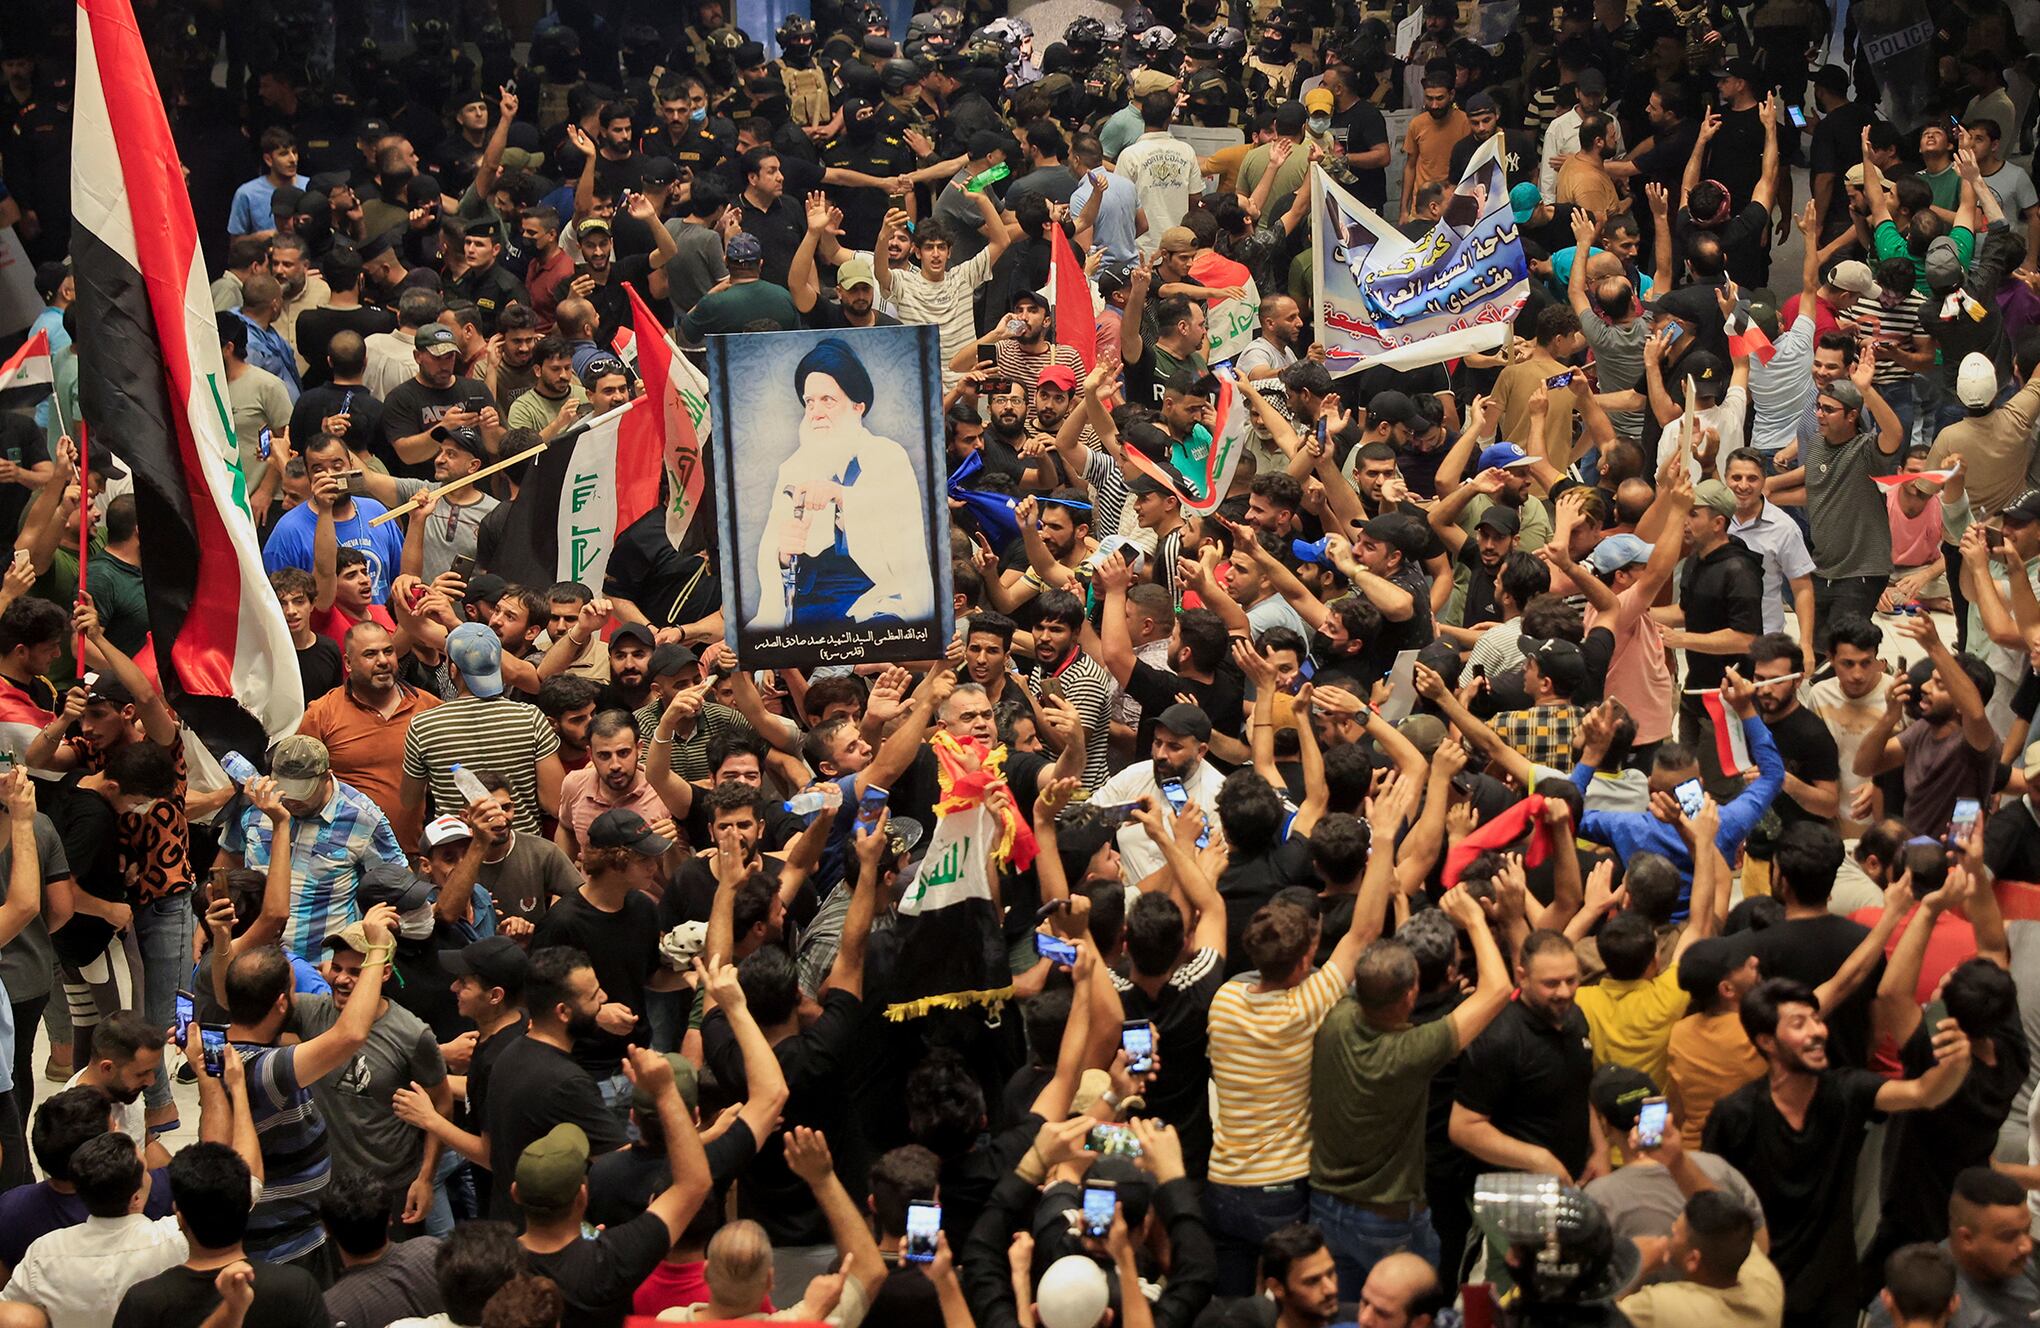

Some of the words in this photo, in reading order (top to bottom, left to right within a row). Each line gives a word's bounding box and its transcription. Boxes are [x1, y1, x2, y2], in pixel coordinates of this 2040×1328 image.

[1868, 22, 1931, 61] POLICE
[1164, 154, 1187, 167] COAST
[1427, 247, 1474, 290] السيد
[1447, 267, 1513, 314] مقتدى
[782, 634, 806, 648] صادق
[807, 636, 826, 646] محمد
[826, 631, 852, 647] الشهيد
[853, 630, 874, 645] السيد
[874, 628, 904, 646] العظمى
[904, 628, 915, 640] الله
[754, 635, 782, 650] الصدر
